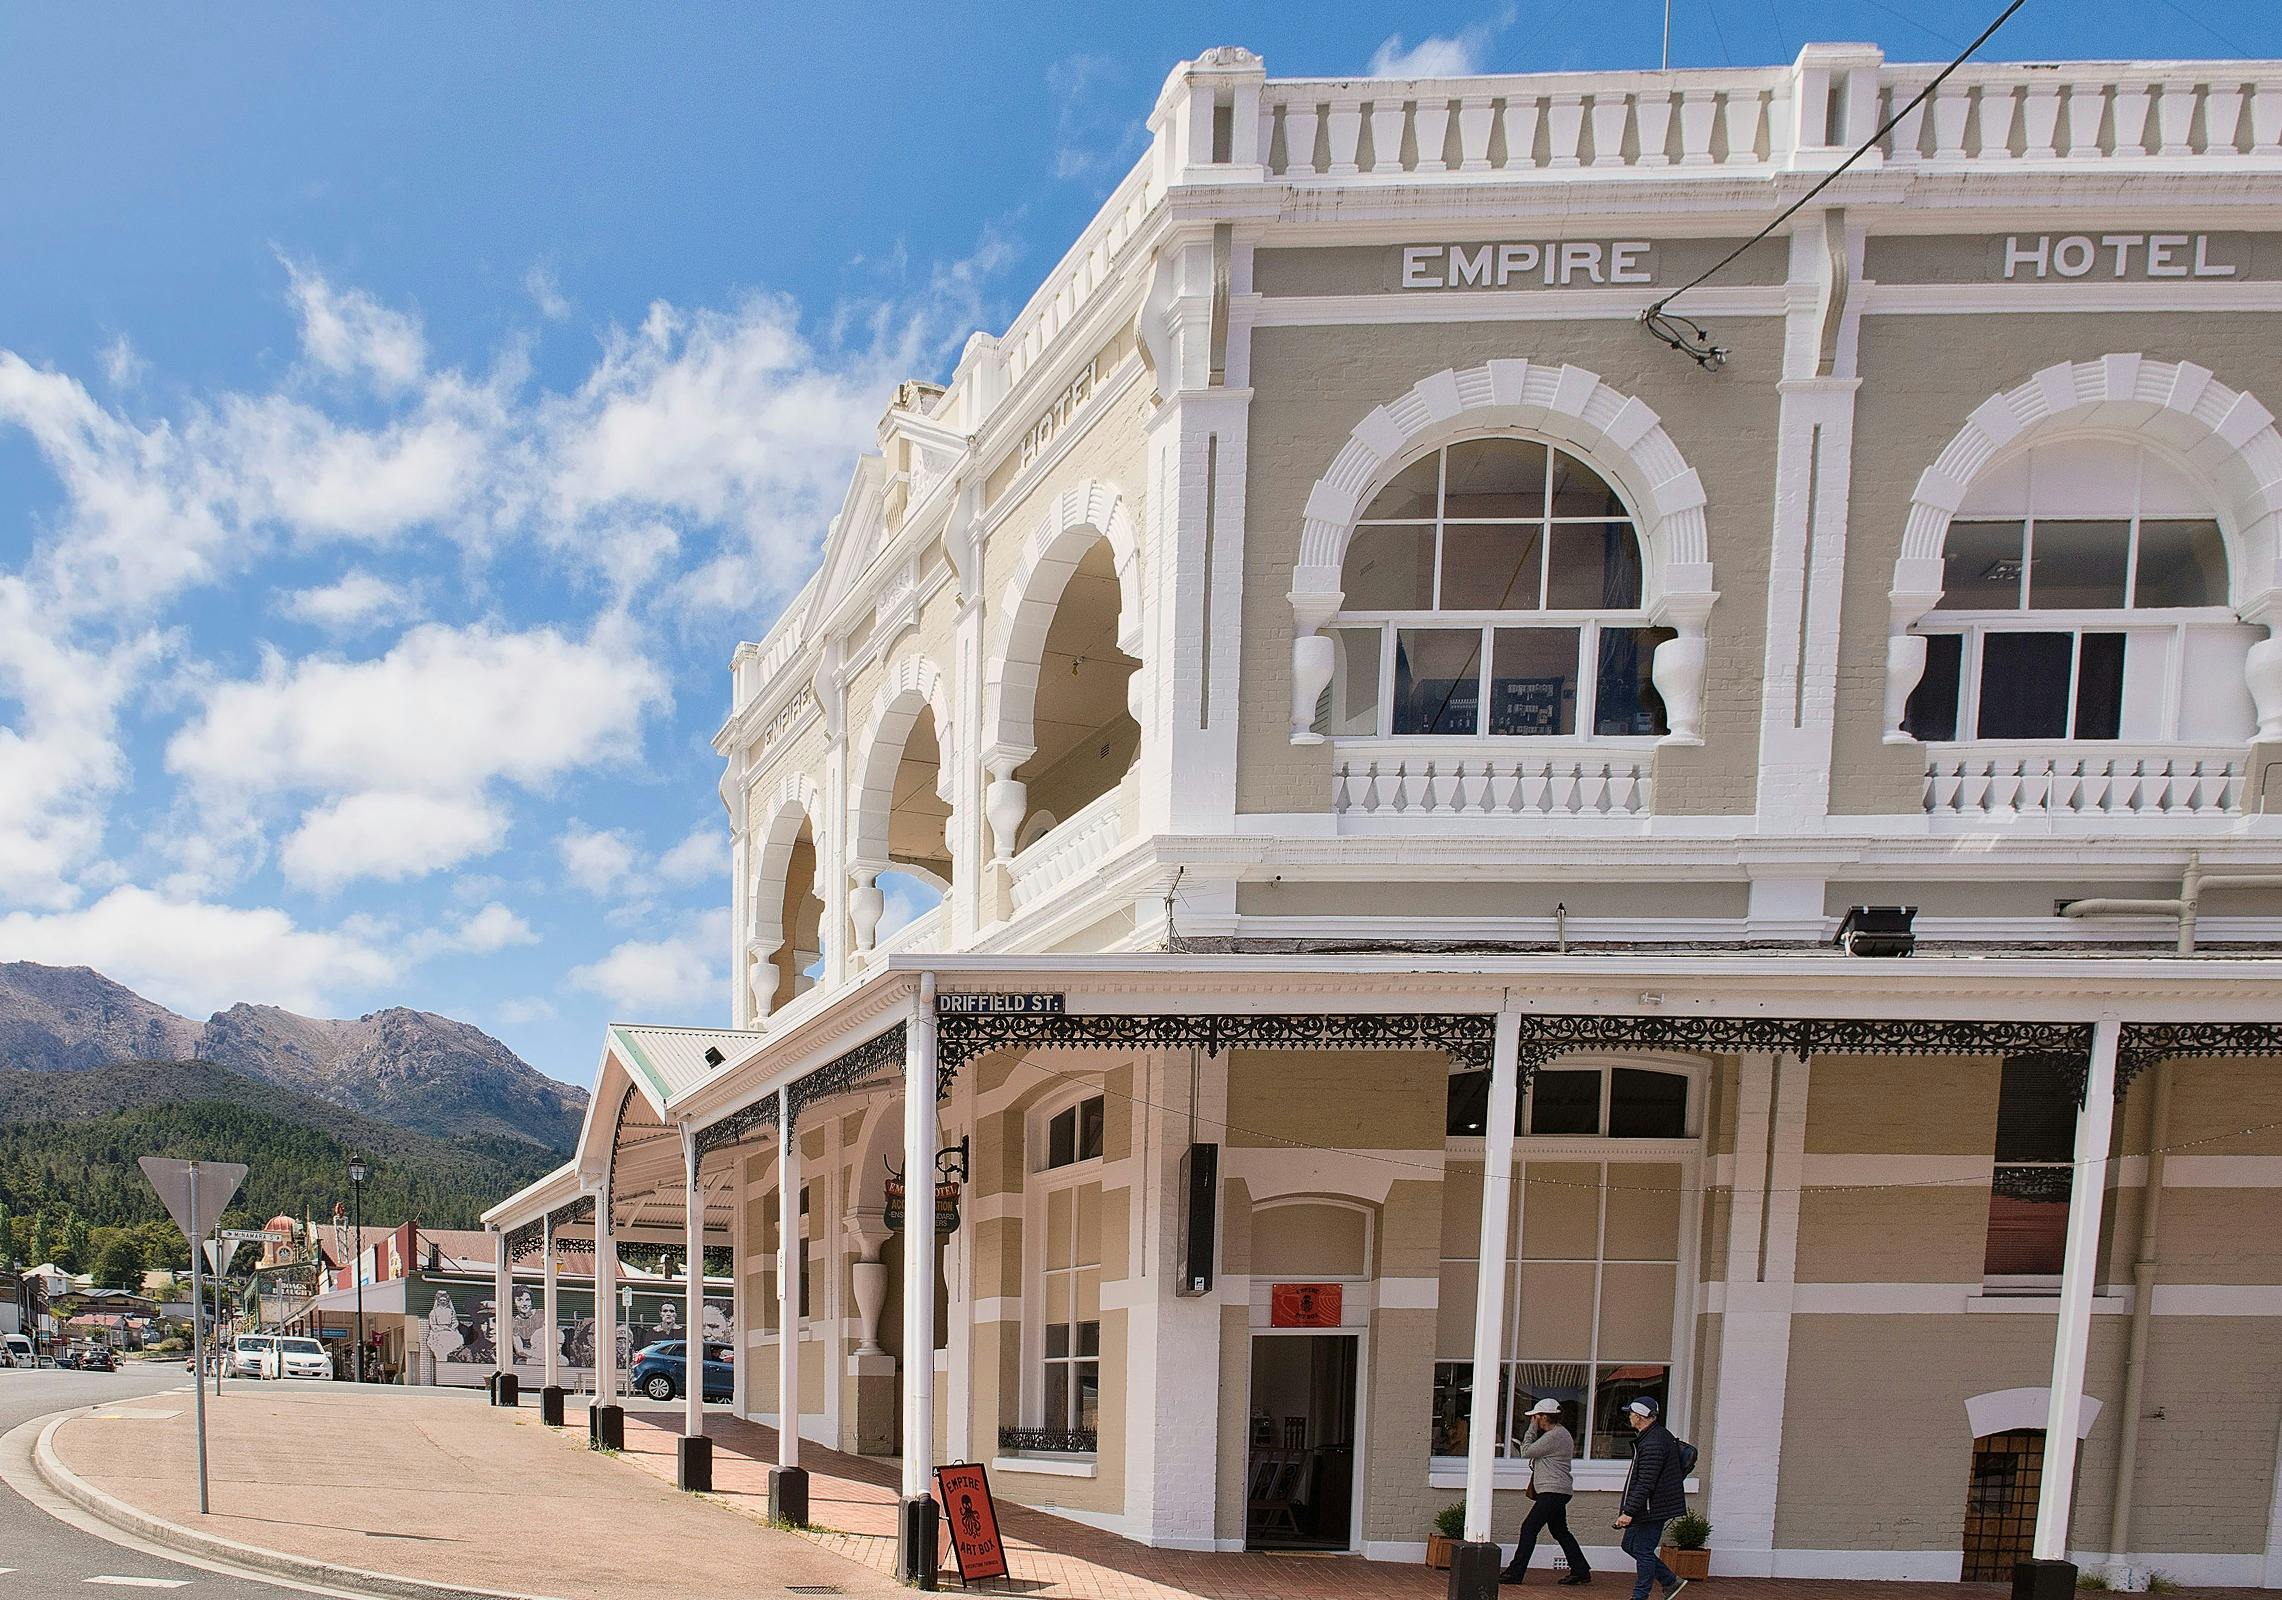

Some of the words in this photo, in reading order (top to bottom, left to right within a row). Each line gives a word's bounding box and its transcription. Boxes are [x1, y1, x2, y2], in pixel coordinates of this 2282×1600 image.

[1402, 242, 1651, 288] EMPIRE
[2003, 235, 2236, 278] HOTEL
[1020, 357, 1109, 468] HOTEL
[940, 995, 1025, 1011] DRIFFIELD
[946, 1476, 980, 1493] EMPIRE
[960, 1541, 977, 1556] ART
[979, 1537, 996, 1555] BOX
